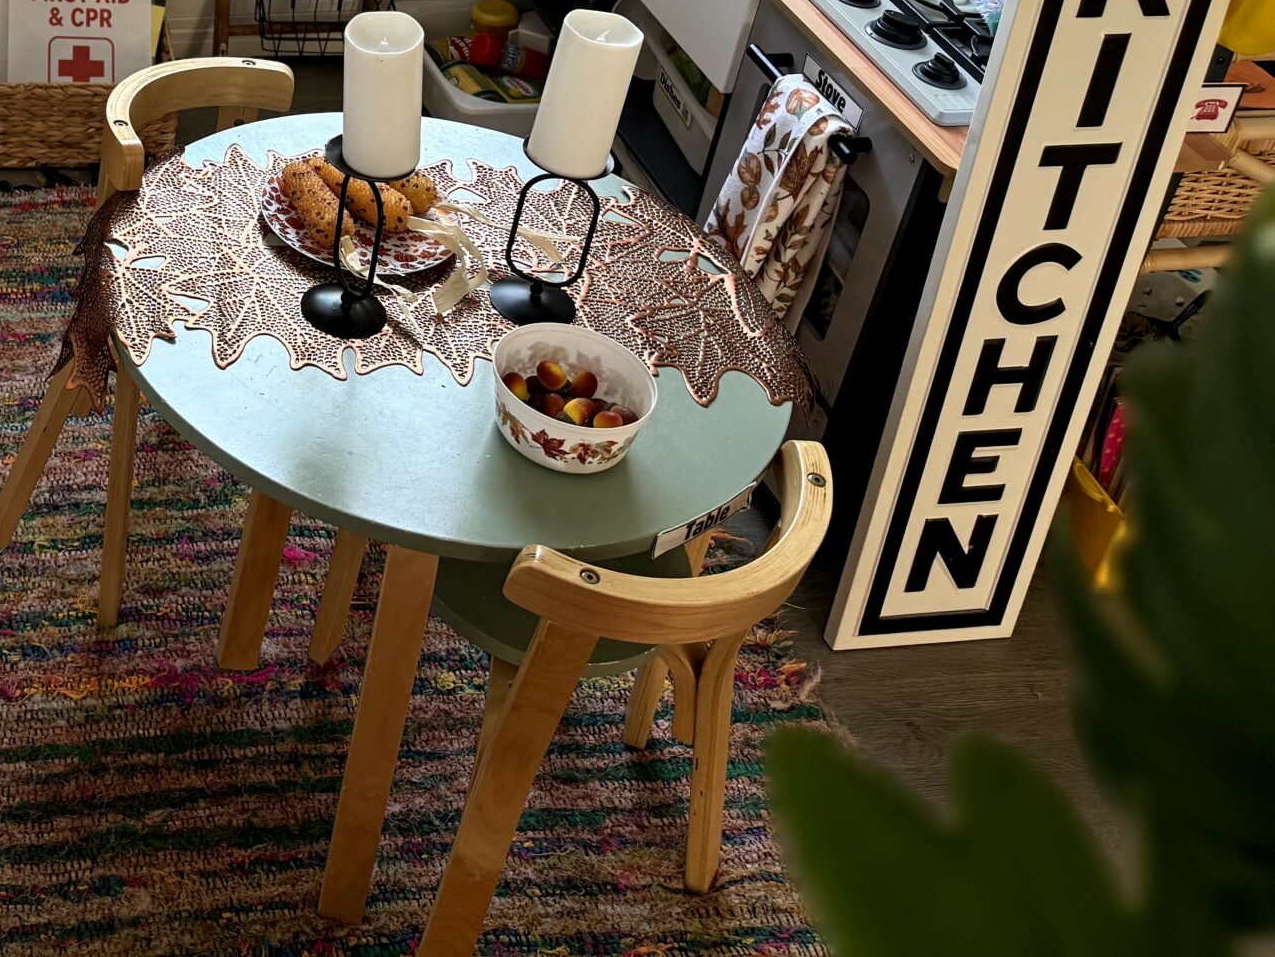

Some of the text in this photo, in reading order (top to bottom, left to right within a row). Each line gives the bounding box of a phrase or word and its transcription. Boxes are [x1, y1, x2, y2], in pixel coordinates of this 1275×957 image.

[48, 7, 113, 28] & CPR
[660, 72, 681, 109] Dishes
[816, 69, 846, 113] Stove
[685, 505, 731, 540] Table
